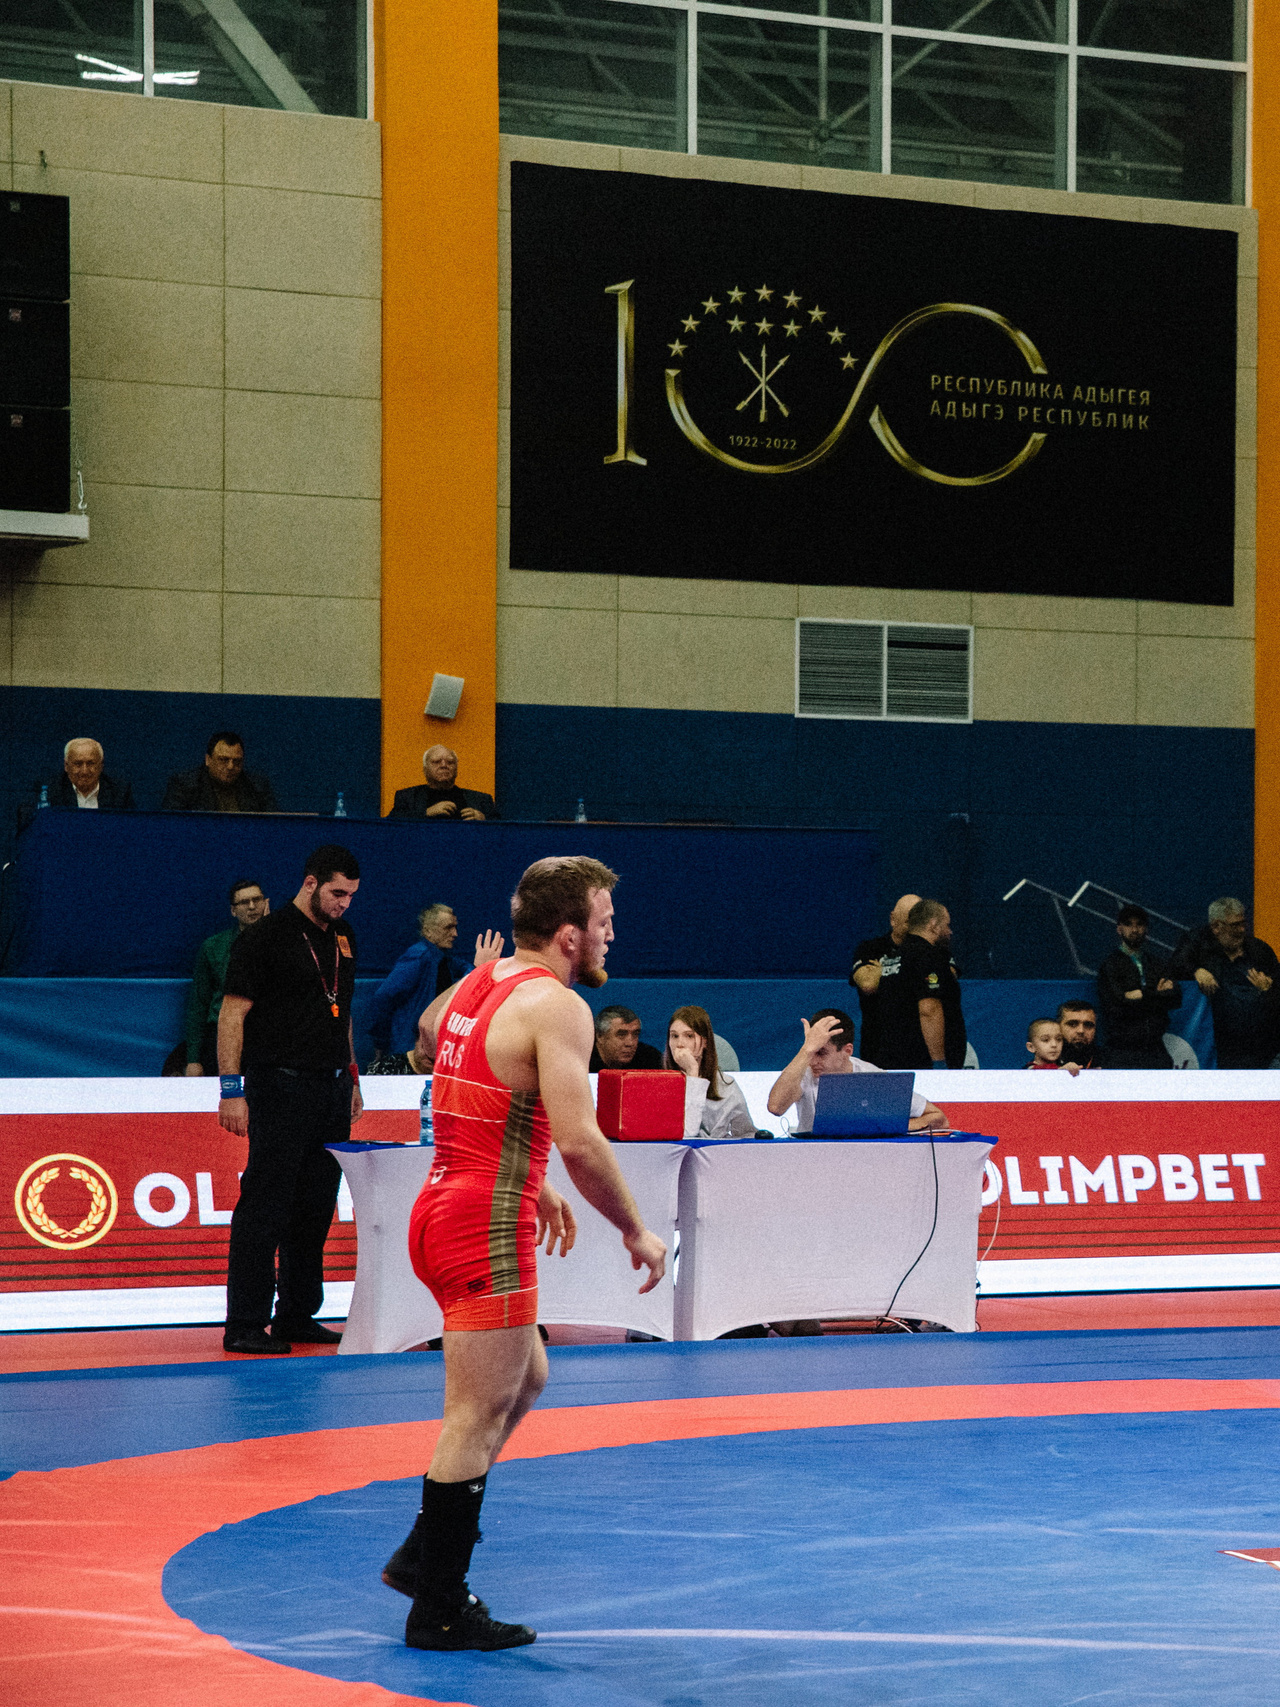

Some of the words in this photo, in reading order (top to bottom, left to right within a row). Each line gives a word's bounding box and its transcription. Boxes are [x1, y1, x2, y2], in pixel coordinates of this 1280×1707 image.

[930, 374, 1064, 400] РЕСПУБЛИКА
[1073, 385, 1150, 406] АДЫГЕЯ
[930, 400, 1004, 420] АДЫГЭ
[1018, 406, 1149, 430] РЕСПУБЛИК
[729, 435, 797, 450] 1922-2022
[438, 1040, 465, 1069] RUS
